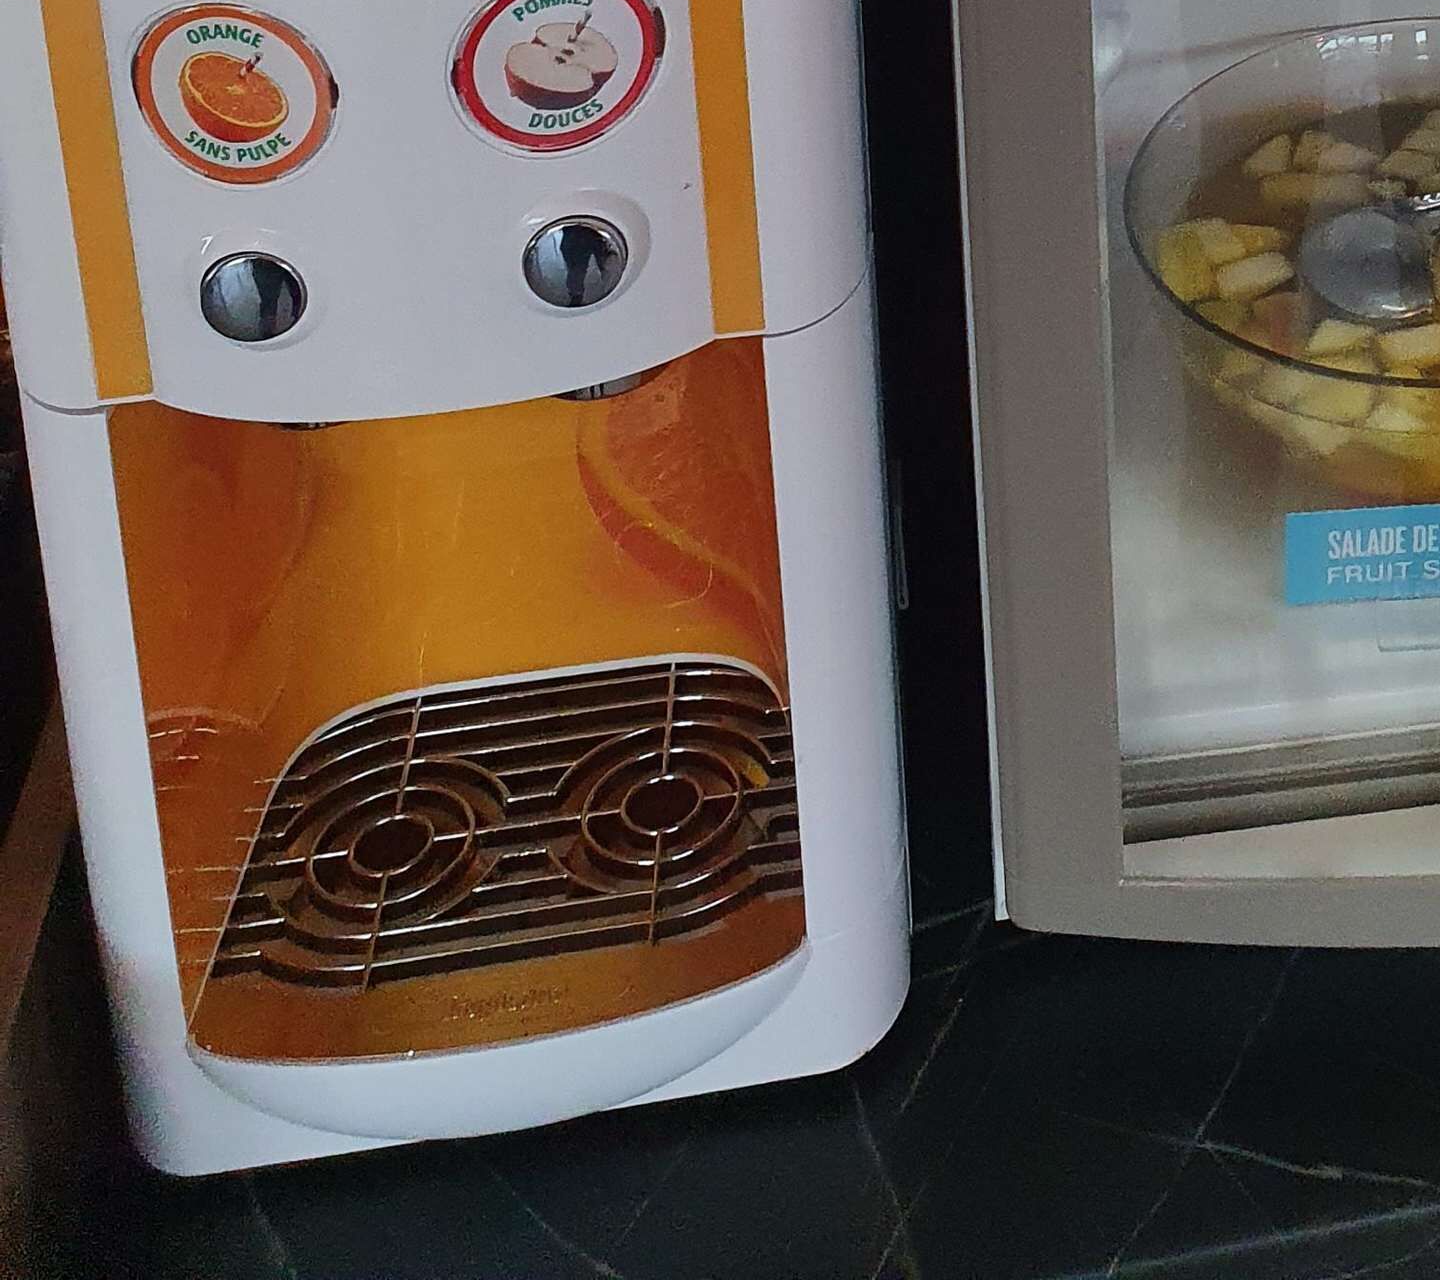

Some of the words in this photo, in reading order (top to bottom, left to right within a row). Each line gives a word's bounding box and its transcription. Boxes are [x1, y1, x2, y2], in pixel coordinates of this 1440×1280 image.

[186, 23, 265, 49] ORANGE
[528, 98, 604, 129] DOUCES
[184, 130, 231, 162] SANS
[237, 132, 292, 163] PULPE
[1327, 524, 1407, 560] SALADE
[1412, 523, 1440, 553] DE
[1327, 560, 1413, 586] FRUIT
